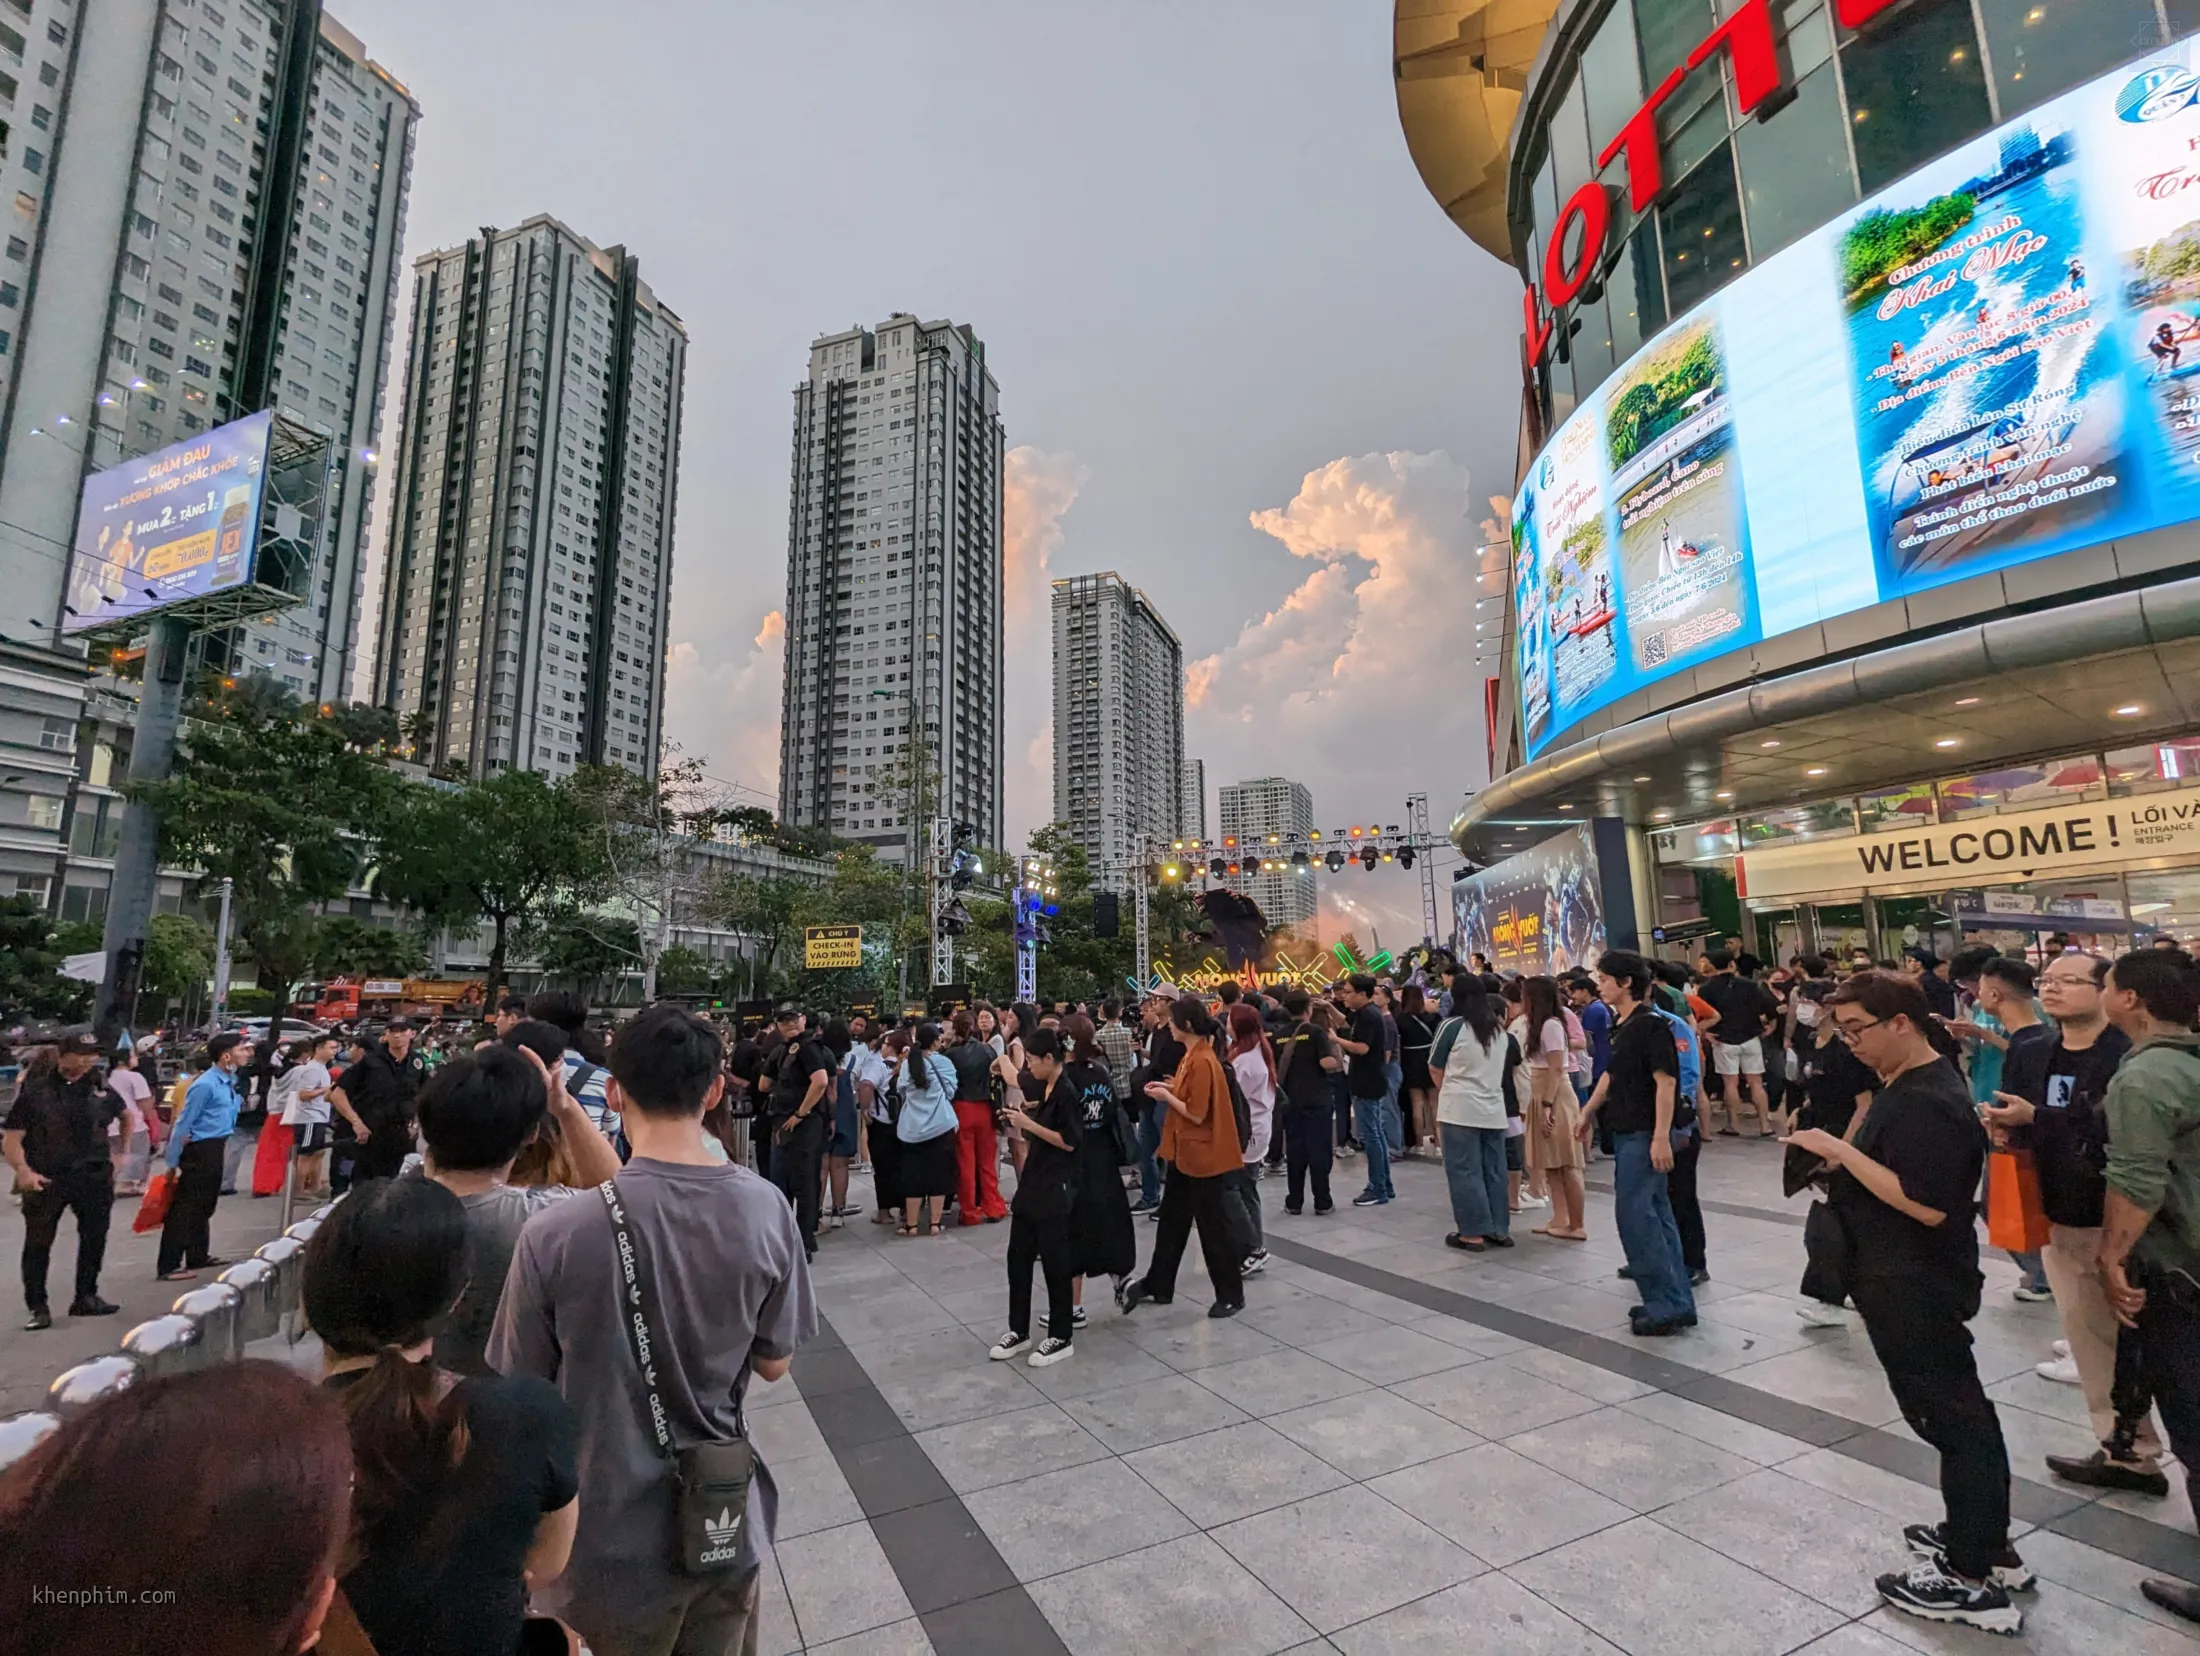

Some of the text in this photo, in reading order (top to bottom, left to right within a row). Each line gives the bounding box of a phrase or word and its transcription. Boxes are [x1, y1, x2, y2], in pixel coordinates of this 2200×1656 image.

[1523, 0, 1896, 369] LOTT
[1889, 216, 2022, 284] Chương trình
[1878, 230, 2048, 320] Khai Mạc
[1936, 354, 1947, 367] 5
[2050, 297, 2089, 320] 2024
[2006, 310, 2016, 321] 8
[2021, 335, 2053, 353] Sao
[2056, 318, 2094, 341] Việt
[2040, 408, 2082, 432] nghệ
[183, 443, 211, 467] ĐAU
[1671, 461, 1700, 482] Cano
[1994, 453, 2034, 475] khai
[1639, 492, 1673, 519] nghiệm
[1696, 462, 1724, 485] sông
[1997, 480, 2039, 506] nghệ
[2040, 465, 2090, 490] thuật
[136, 519, 160, 536] MUA
[160, 506, 173, 528] 2
[179, 504, 206, 522] TẶNG
[207, 490, 216, 512] 1
[1899, 474, 2118, 549] các môn thể thao dưới nước
[1726, 551, 1744, 566] 14h
[2131, 804, 2168, 825] LỐI
[2134, 822, 2195, 836] ENTRANCE
[1857, 817, 2096, 874] WELCOME
[810, 948, 857, 960] VÀO RỪNG
[813, 941, 854, 950] CHECK-IN
[617, 1230, 636, 1284] adidas
[633, 1311, 651, 1365] adidas
[650, 1392, 669, 1446] adidas
[700, 1546, 737, 1563] adidas
